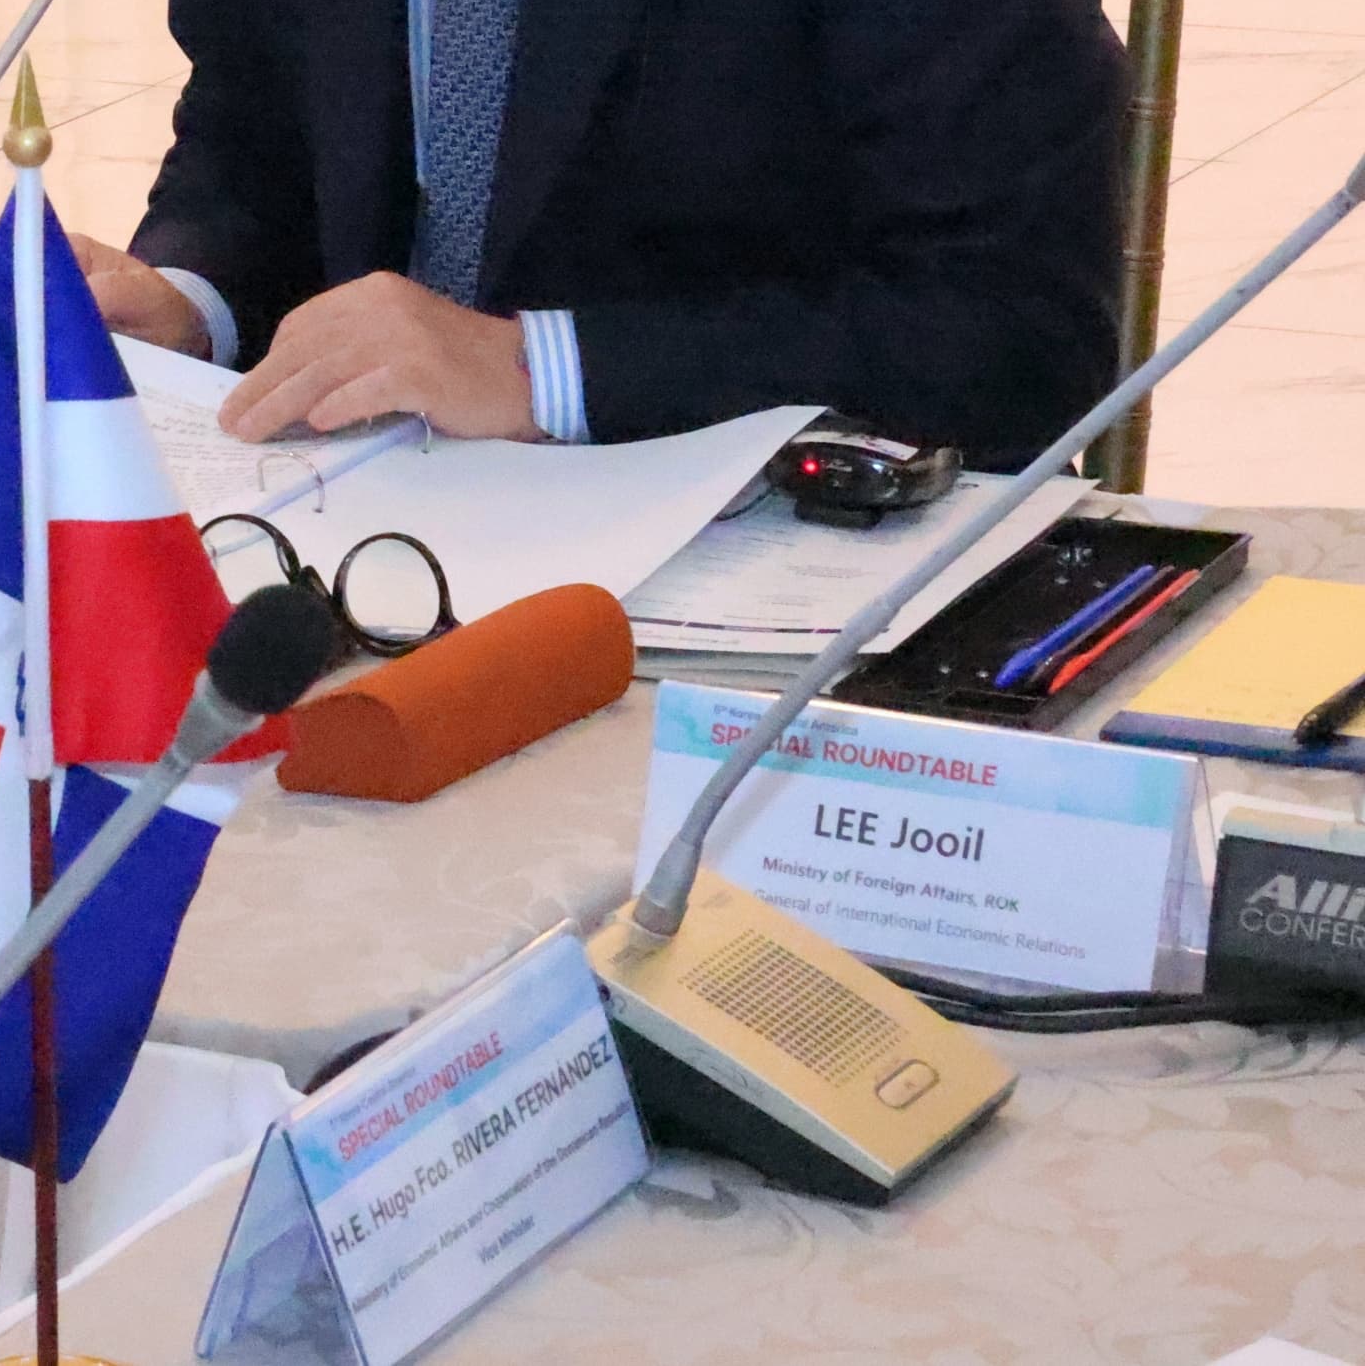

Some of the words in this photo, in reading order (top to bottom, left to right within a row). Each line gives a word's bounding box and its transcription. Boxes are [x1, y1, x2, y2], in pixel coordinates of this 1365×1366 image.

[711, 722, 814, 759] SPIAL
[822, 739, 998, 787] ROUNDTABLE
[814, 803, 880, 847] LEE
[890, 816, 986, 863] Jooil
[762, 856, 828, 883] Ministry
[832, 869, 851, 884] of
[854, 870, 916, 898] Foreign
[922, 883, 978, 909] Affairs,
[983, 893, 1020, 914] ROK
[815, 900, 832, 915] of
[936, 918, 1010, 947] Economic
[1015, 934, 1086, 960] Relations
[338, 1102, 405, 1162] SPECIAL
[403, 1030, 504, 1116] ROUNDTABLE
[330, 1213, 371, 1257] H.E.
[368, 1182, 416, 1230] Hugo
[414, 1158, 453, 1196] Fco.
[451, 1105, 518, 1169] RIVERA
[514, 1033, 614, 1123] FERNÁNDEZ
